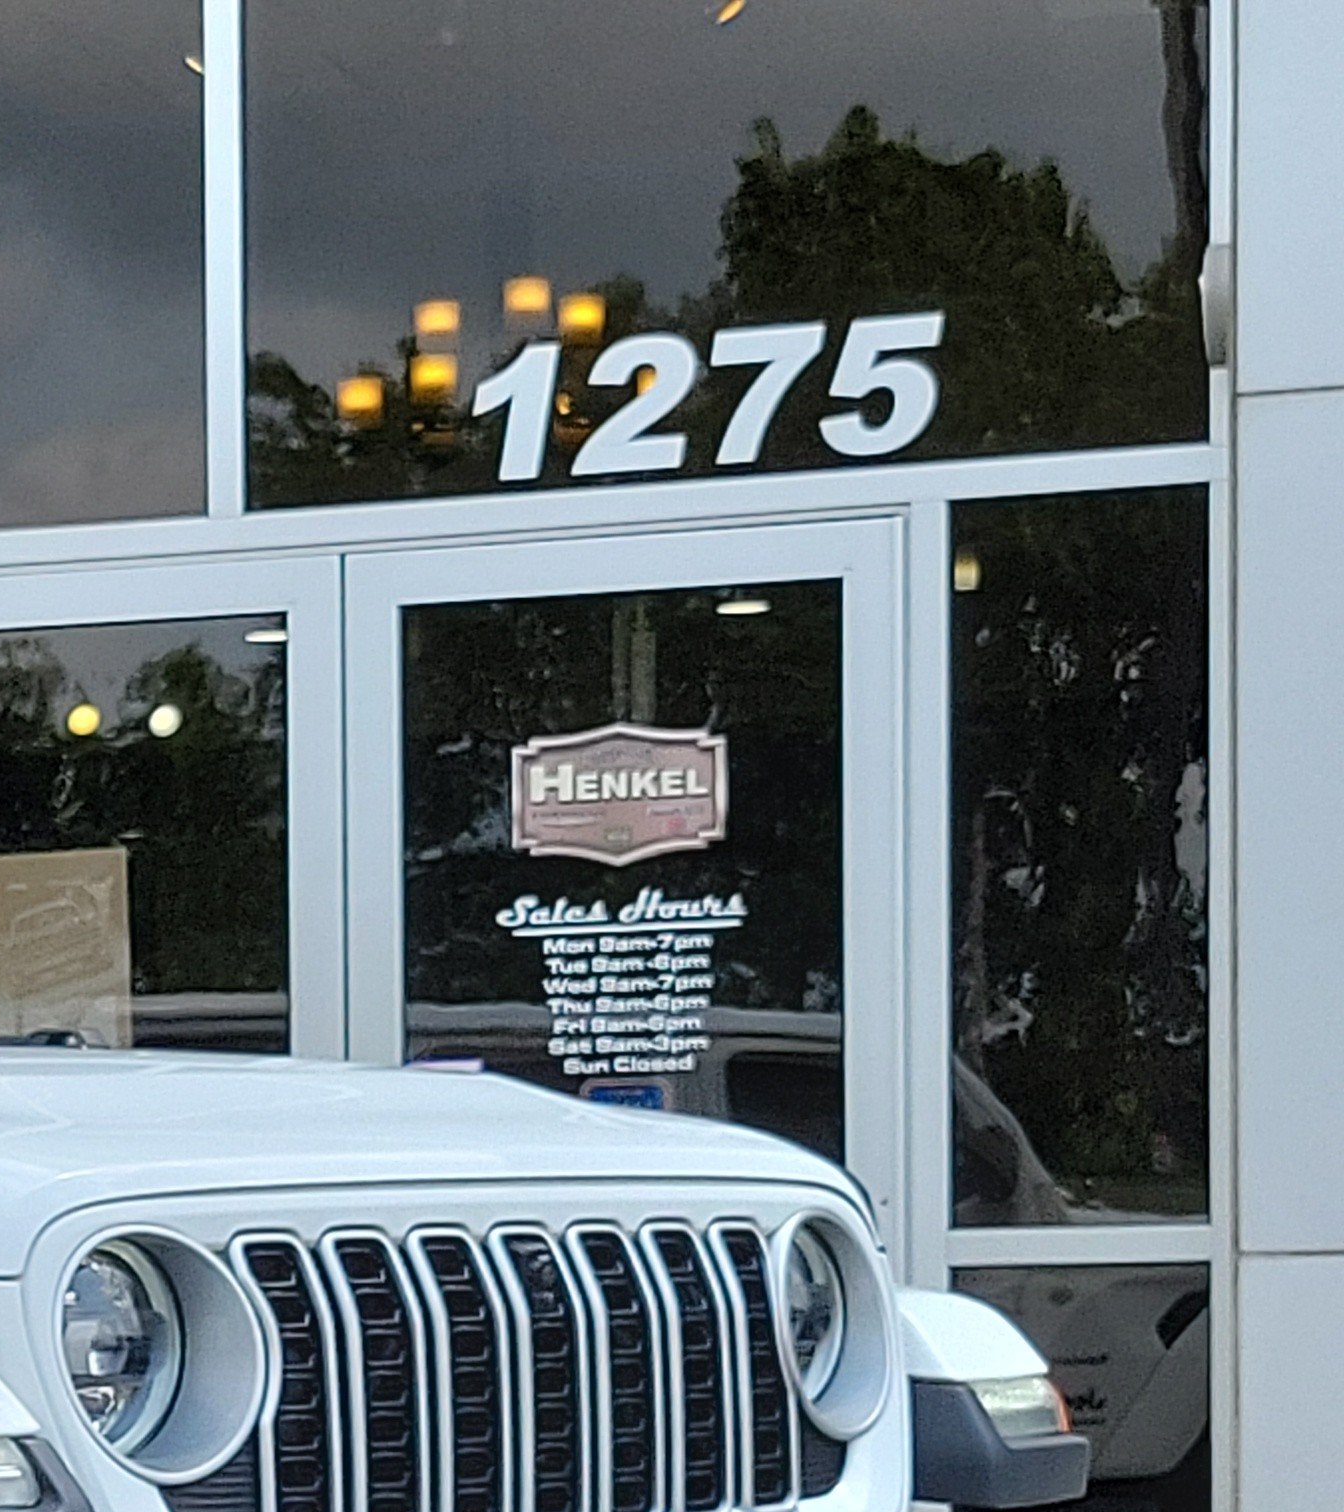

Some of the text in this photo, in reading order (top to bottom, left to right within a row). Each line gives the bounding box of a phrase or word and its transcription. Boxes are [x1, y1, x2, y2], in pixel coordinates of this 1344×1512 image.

[472, 308, 945, 482] 1275
[529, 764, 710, 804] HENKEL
[495, 886, 749, 928] Sales Hours
[542, 938, 596, 955] Mon
[544, 957, 589, 974] Tue
[542, 976, 597, 994] Wed
[546, 998, 593, 1015] Thu
[553, 1017, 586, 1034] Fri
[547, 1038, 593, 1056] Sat
[563, 1053, 696, 1075] Sun Closed
